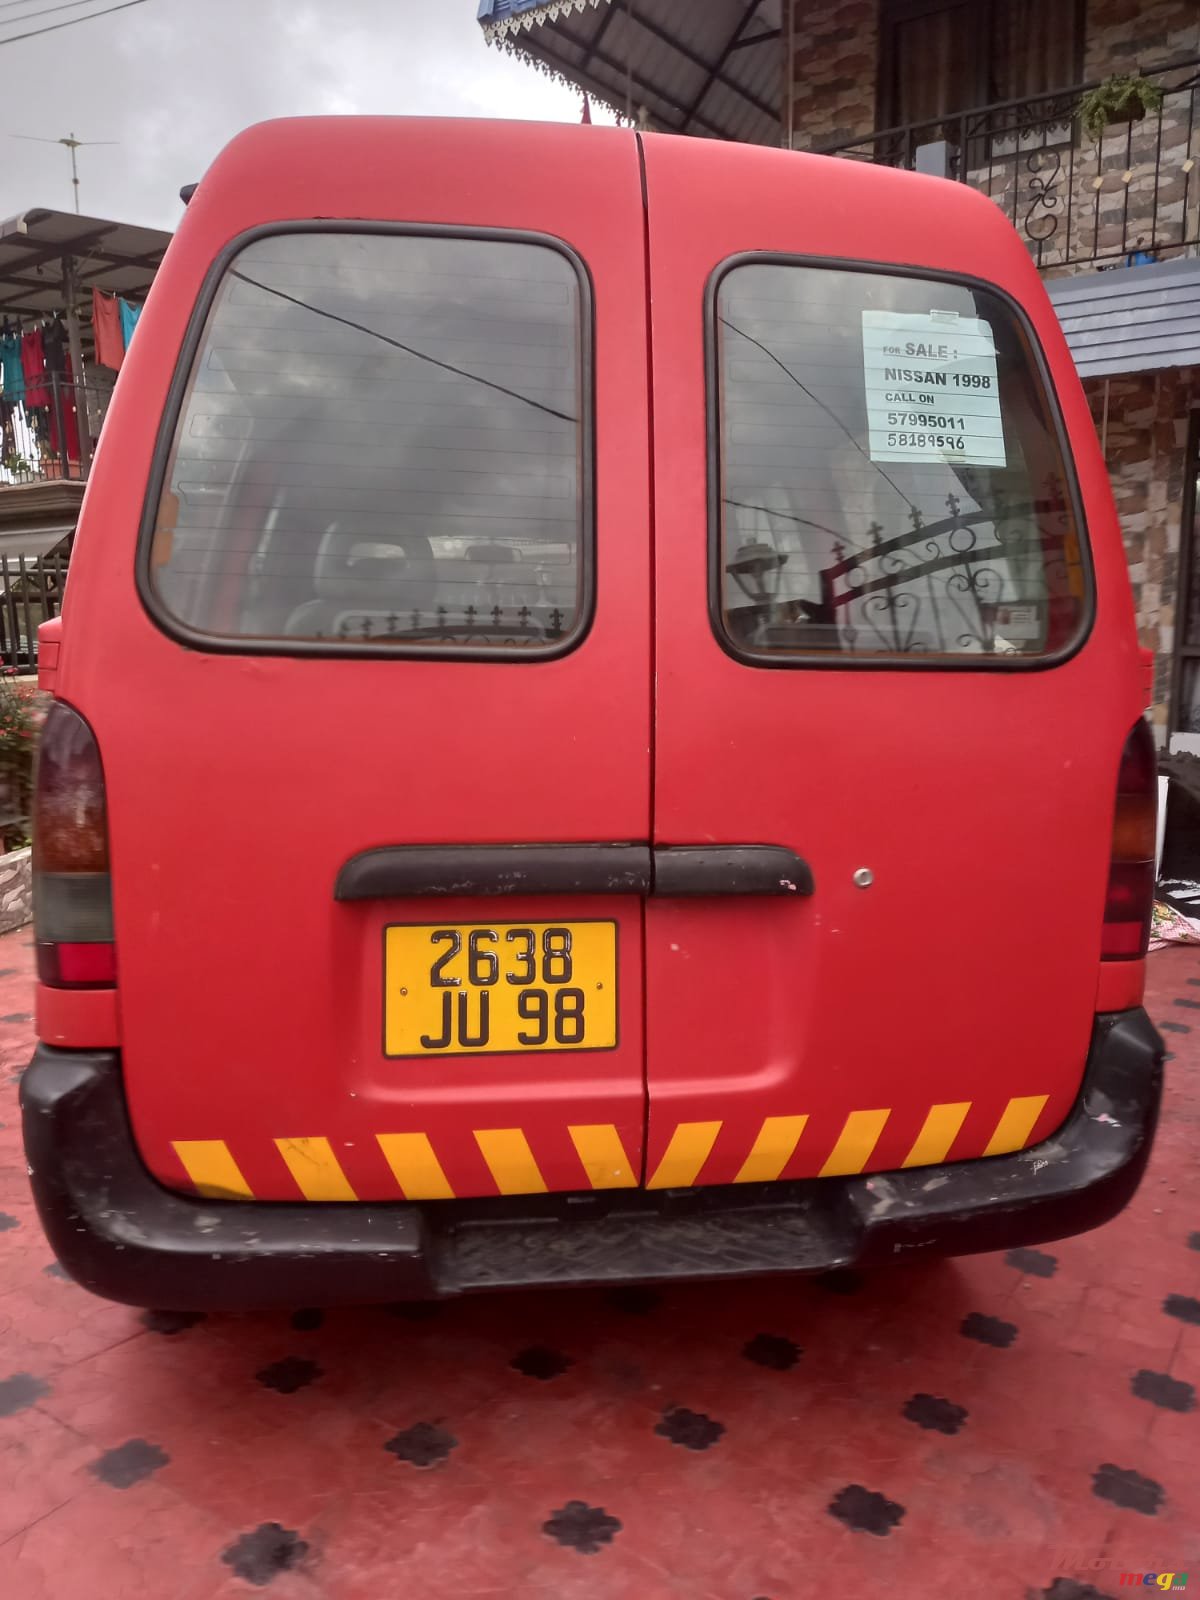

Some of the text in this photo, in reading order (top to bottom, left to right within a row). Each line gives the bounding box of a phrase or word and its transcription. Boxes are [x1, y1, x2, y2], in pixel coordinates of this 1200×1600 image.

[905, 342, 948, 358] SALE
[885, 368, 991, 389] NISSAN 1998
[885, 393, 935, 404] CALL ON
[888, 413, 965, 430] 57995011
[888, 433, 965, 450] 58189596
[430, 928, 572, 987] 2638
[420, 988, 585, 1049] JU 98
